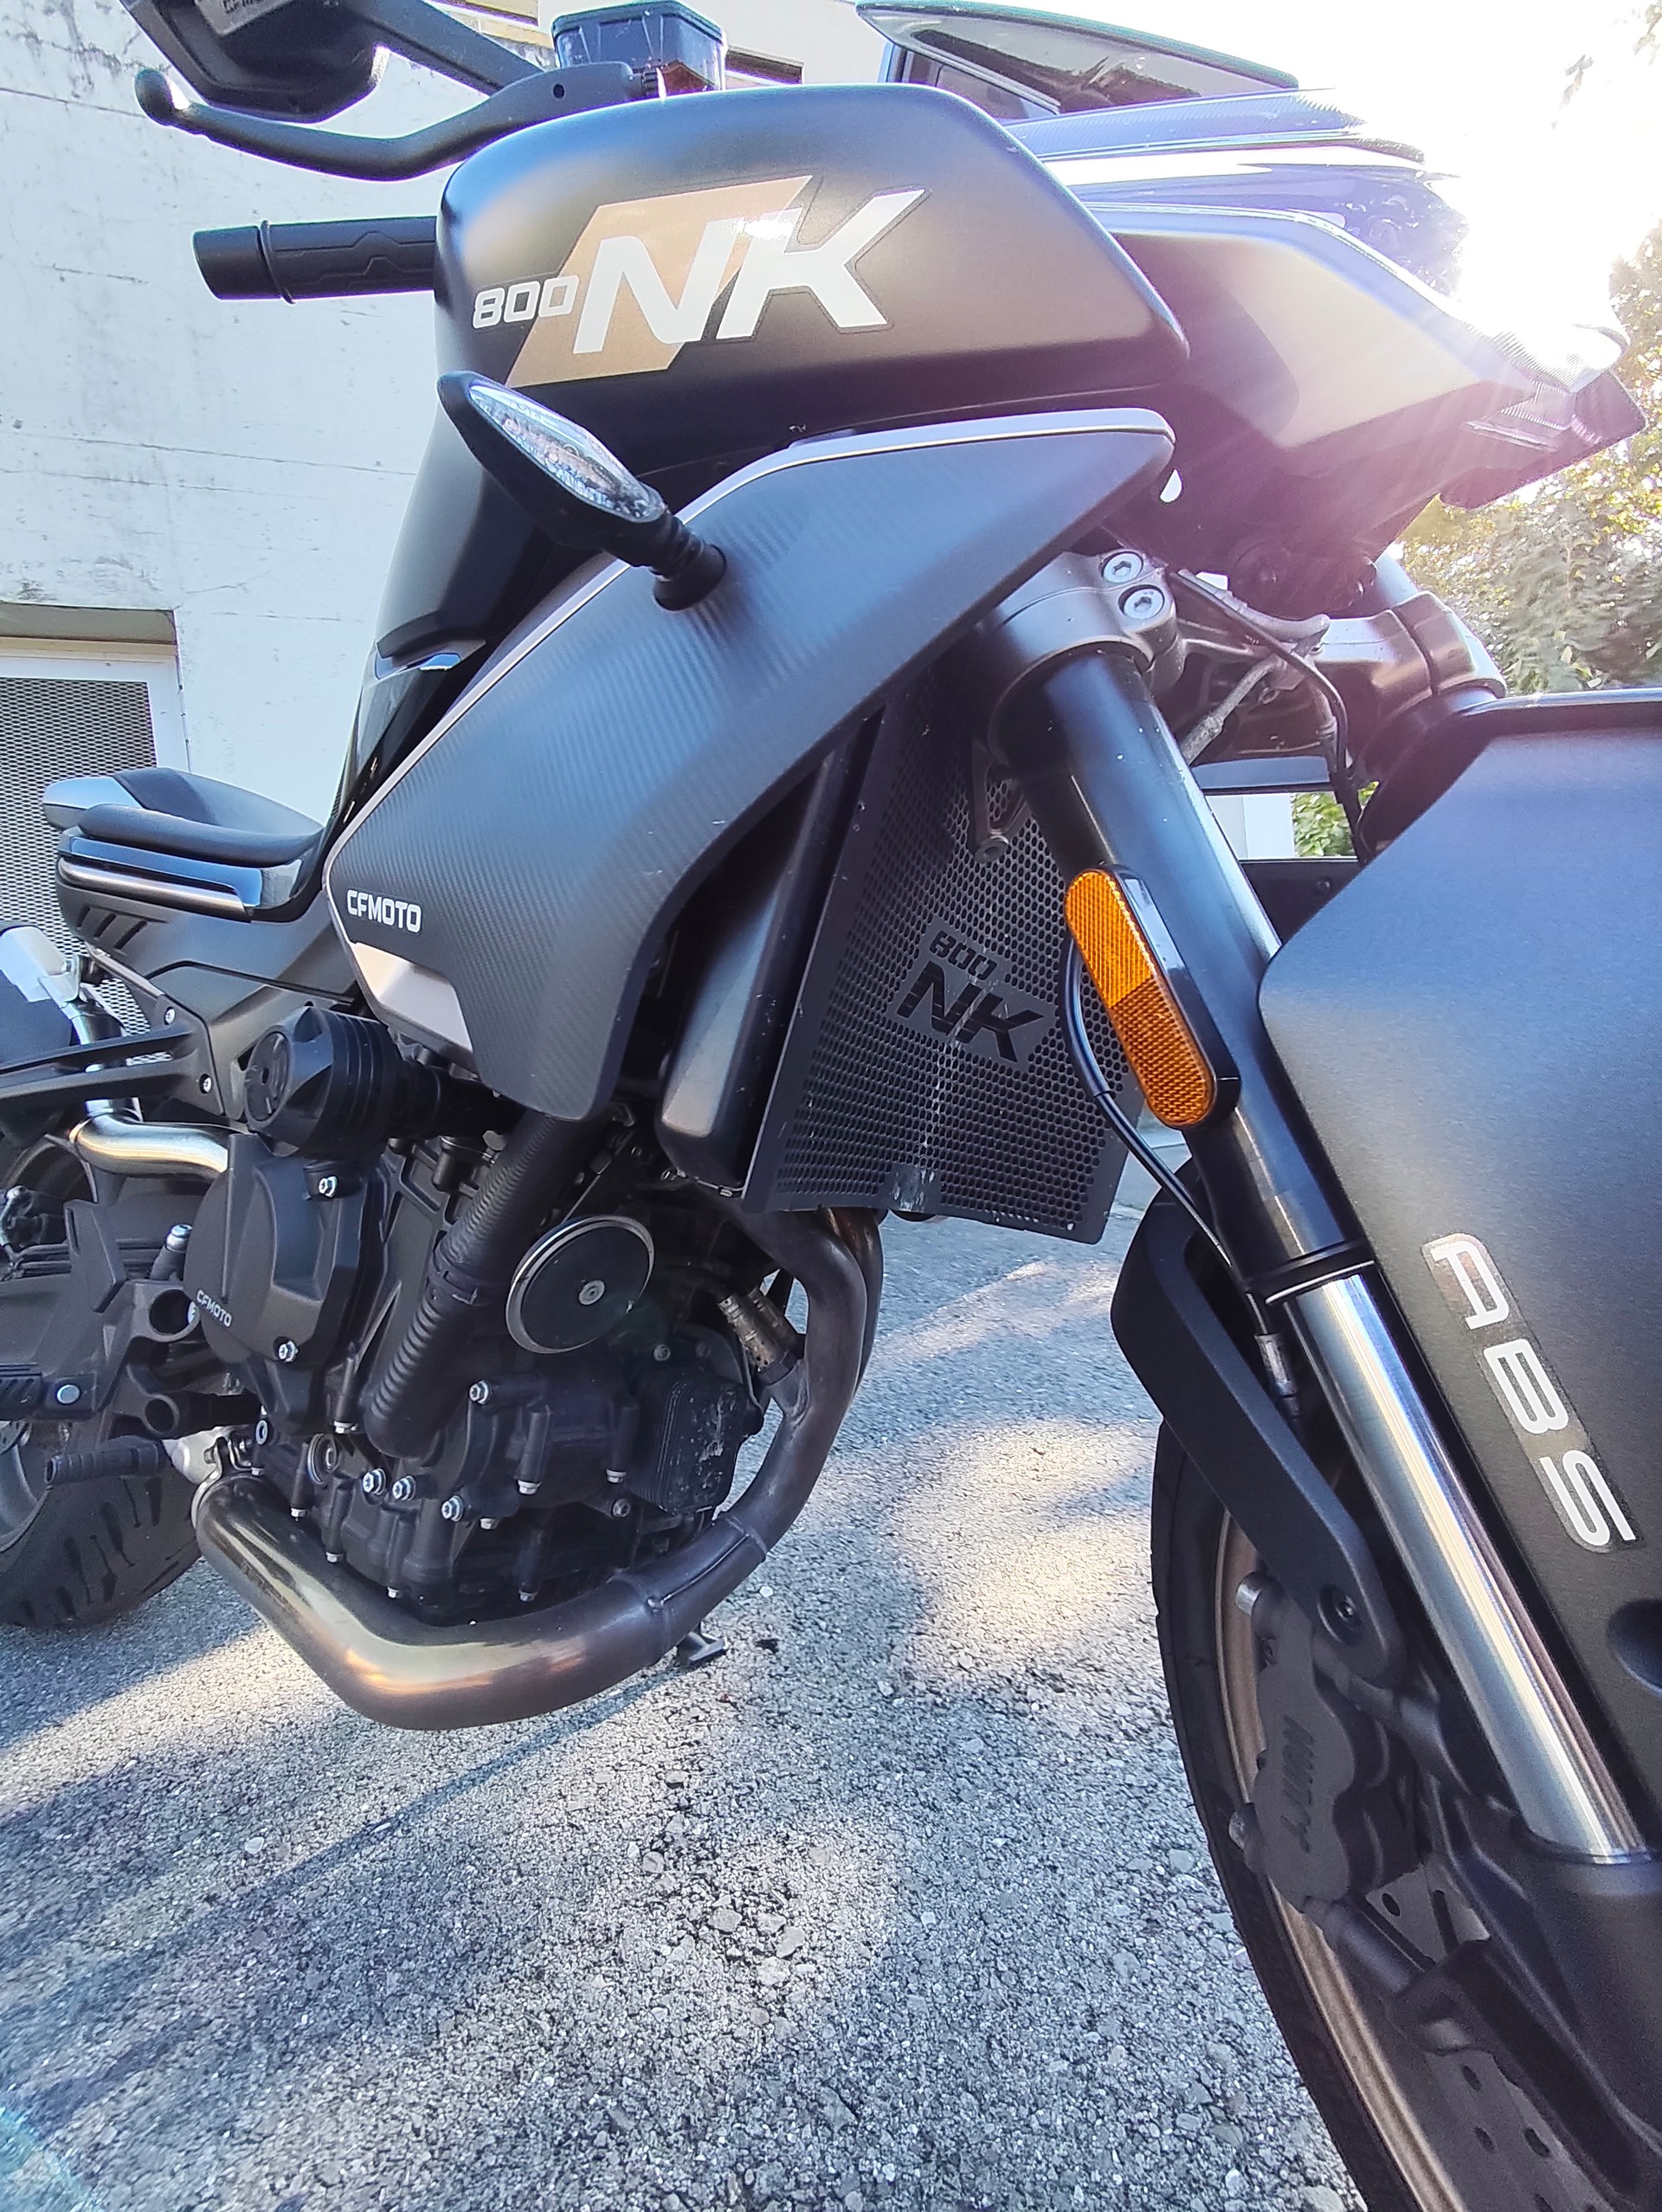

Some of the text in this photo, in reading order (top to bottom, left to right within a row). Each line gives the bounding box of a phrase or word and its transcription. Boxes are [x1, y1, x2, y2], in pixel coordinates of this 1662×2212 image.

[473, 189, 925, 354] 800 NK
[347, 889, 422, 933] CFMOTO
[929, 931, 997, 980] 800
[896, 961, 1044, 1063] NK
[196, 1289, 232, 1327] CFMOTO
[1430, 1240, 1636, 1545] ABS
